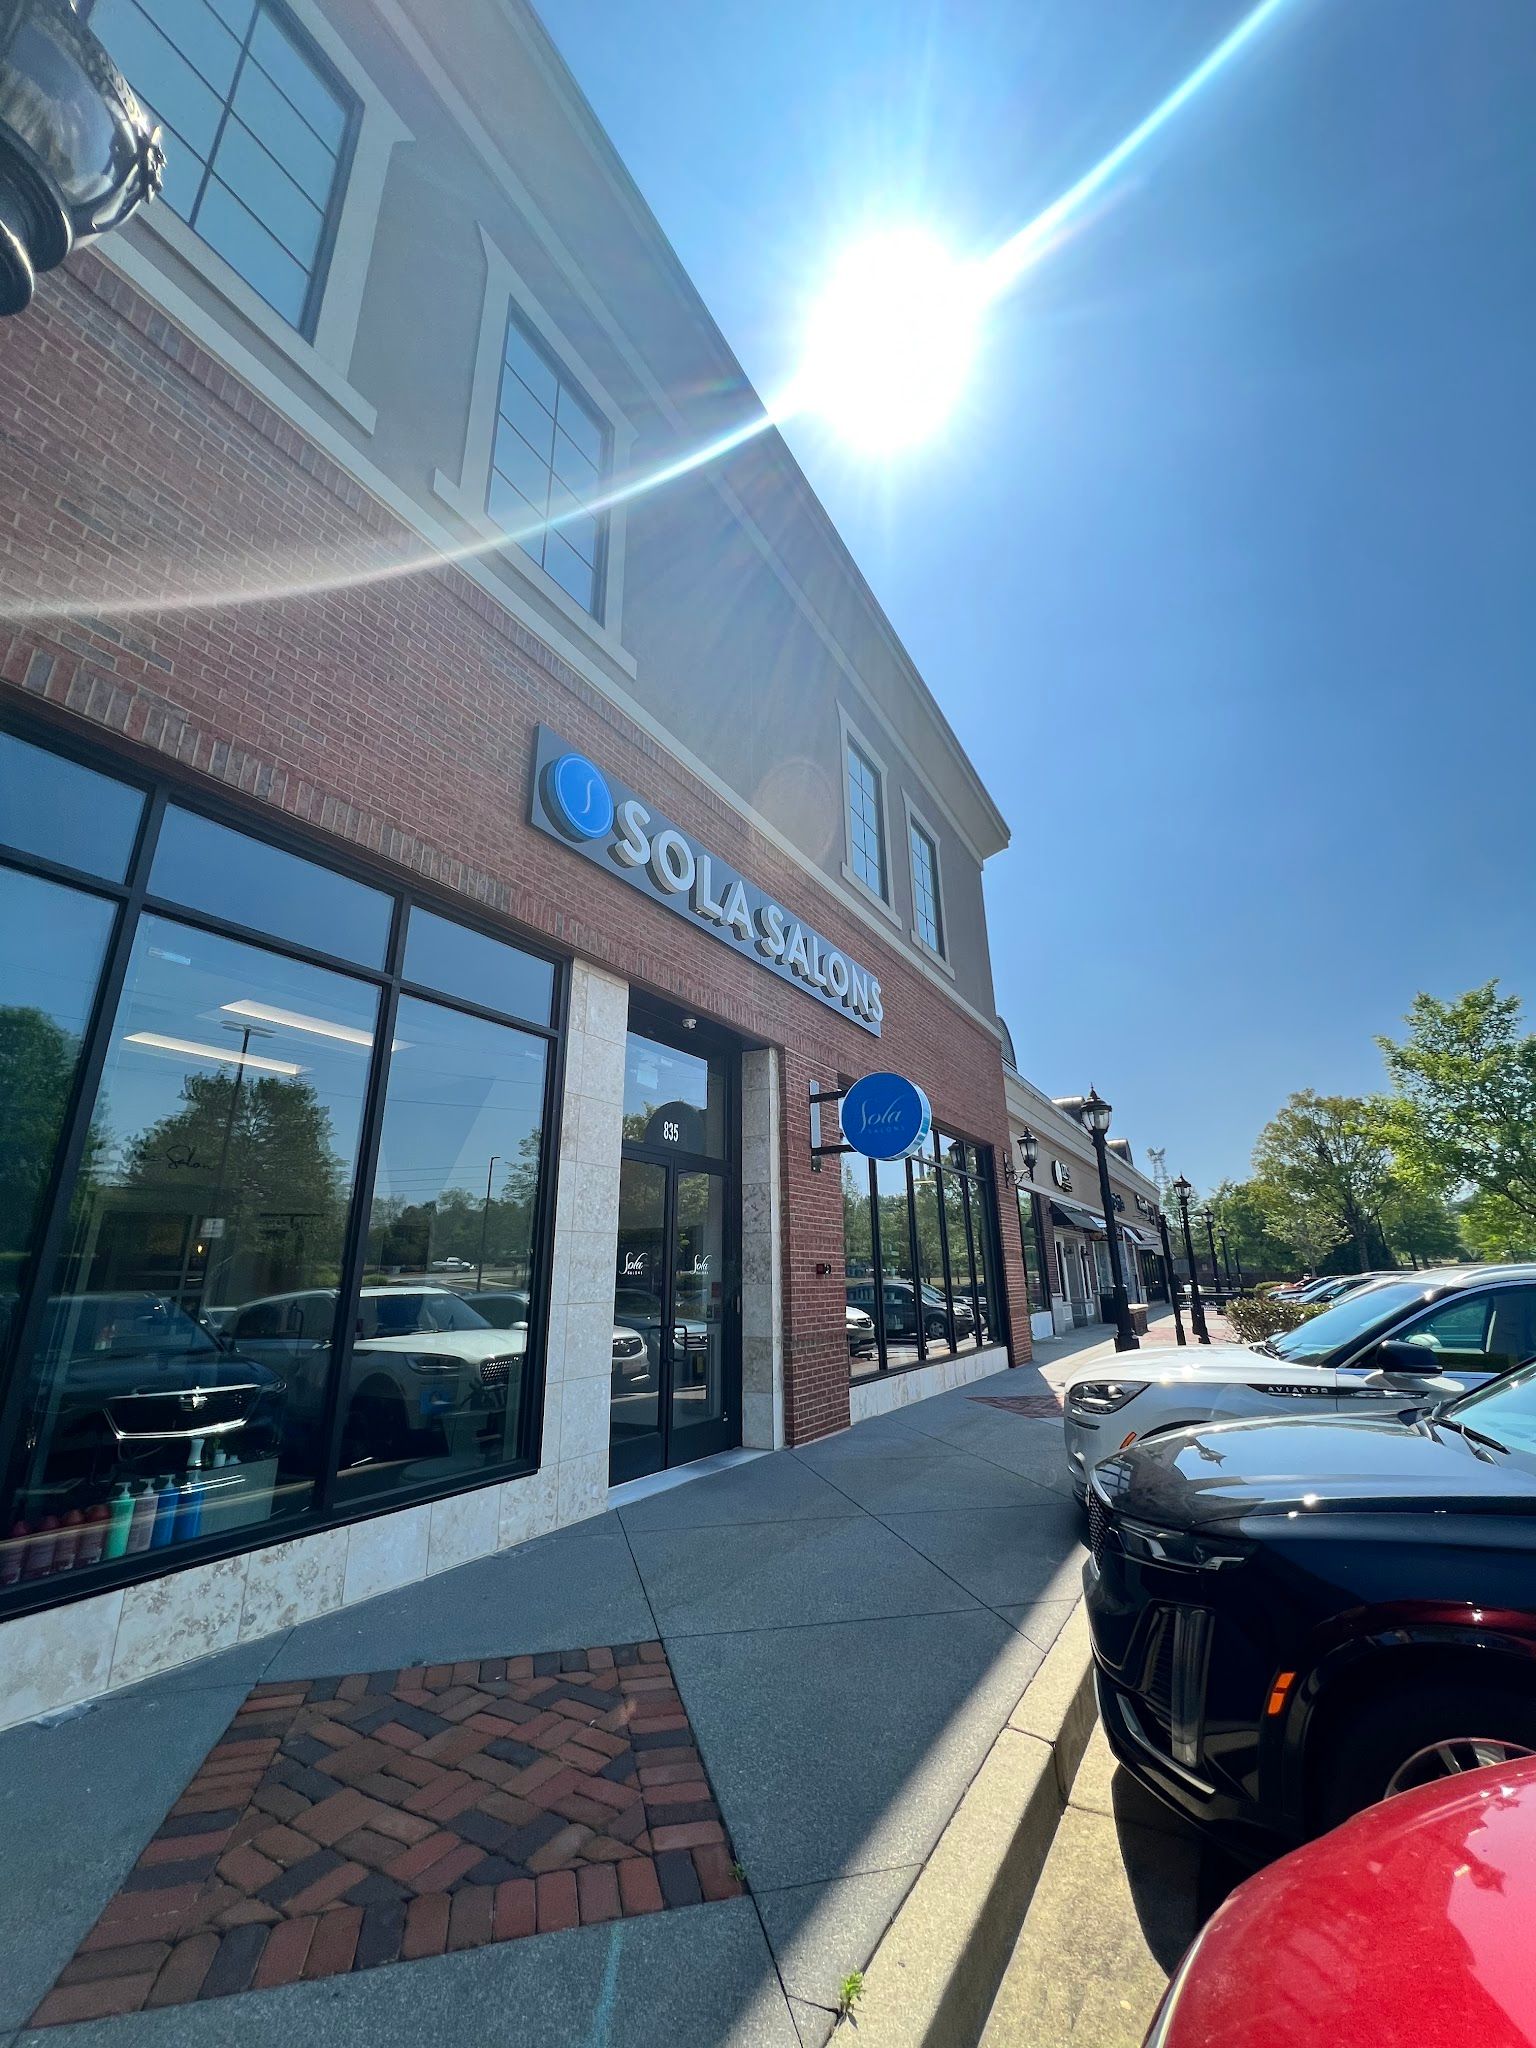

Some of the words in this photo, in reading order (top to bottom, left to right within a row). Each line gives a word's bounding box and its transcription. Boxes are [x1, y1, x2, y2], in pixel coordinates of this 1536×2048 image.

[608, 800, 754, 941] SOLA
[755, 904, 884, 1024] SALONS
[858, 1094, 905, 1133] Sola
[663, 1121, 679, 1142] 835
[619, 1251, 648, 1275] Sola
[690, 1254, 713, 1275] Sola
[1267, 1386, 1329, 1394] AVIATOR
